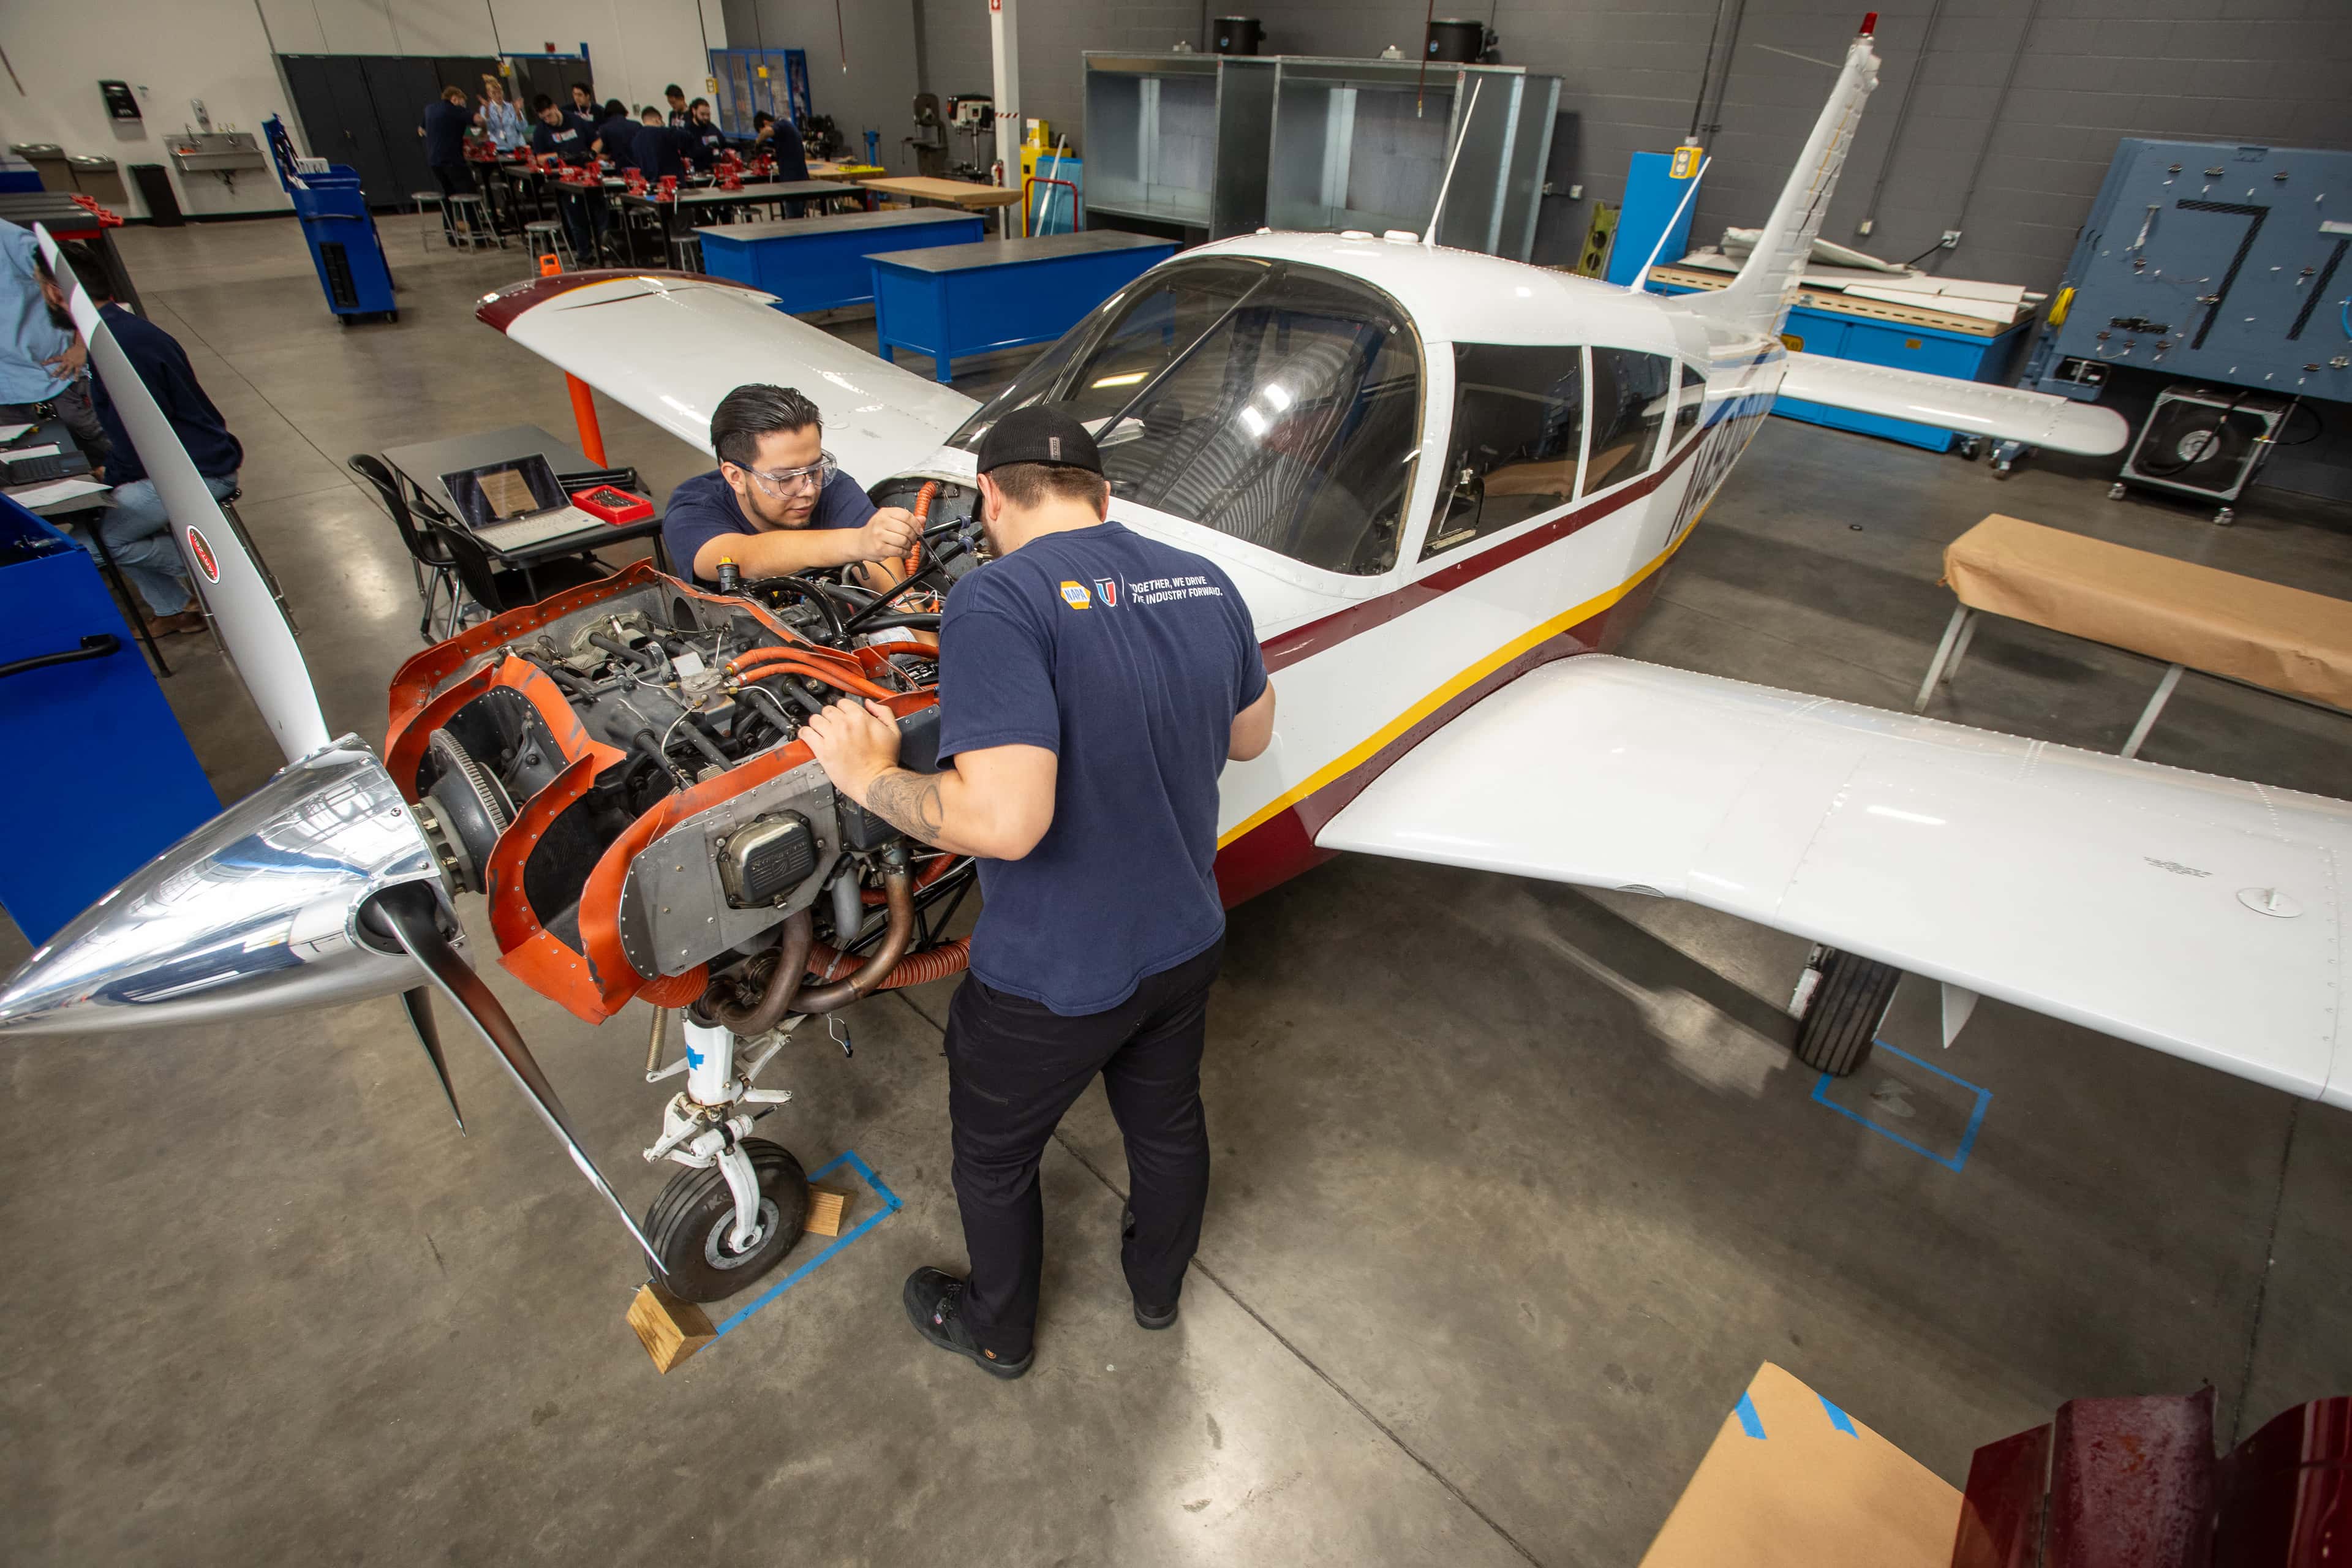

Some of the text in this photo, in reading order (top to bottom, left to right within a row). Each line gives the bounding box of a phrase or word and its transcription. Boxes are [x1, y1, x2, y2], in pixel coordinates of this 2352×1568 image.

[1172, 578, 1185, 587] WE
[1185, 576, 1207, 586] DRIVE
[1064, 588, 1088, 601] NAPA
[1146, 589, 1187, 605] INDUSTRY
